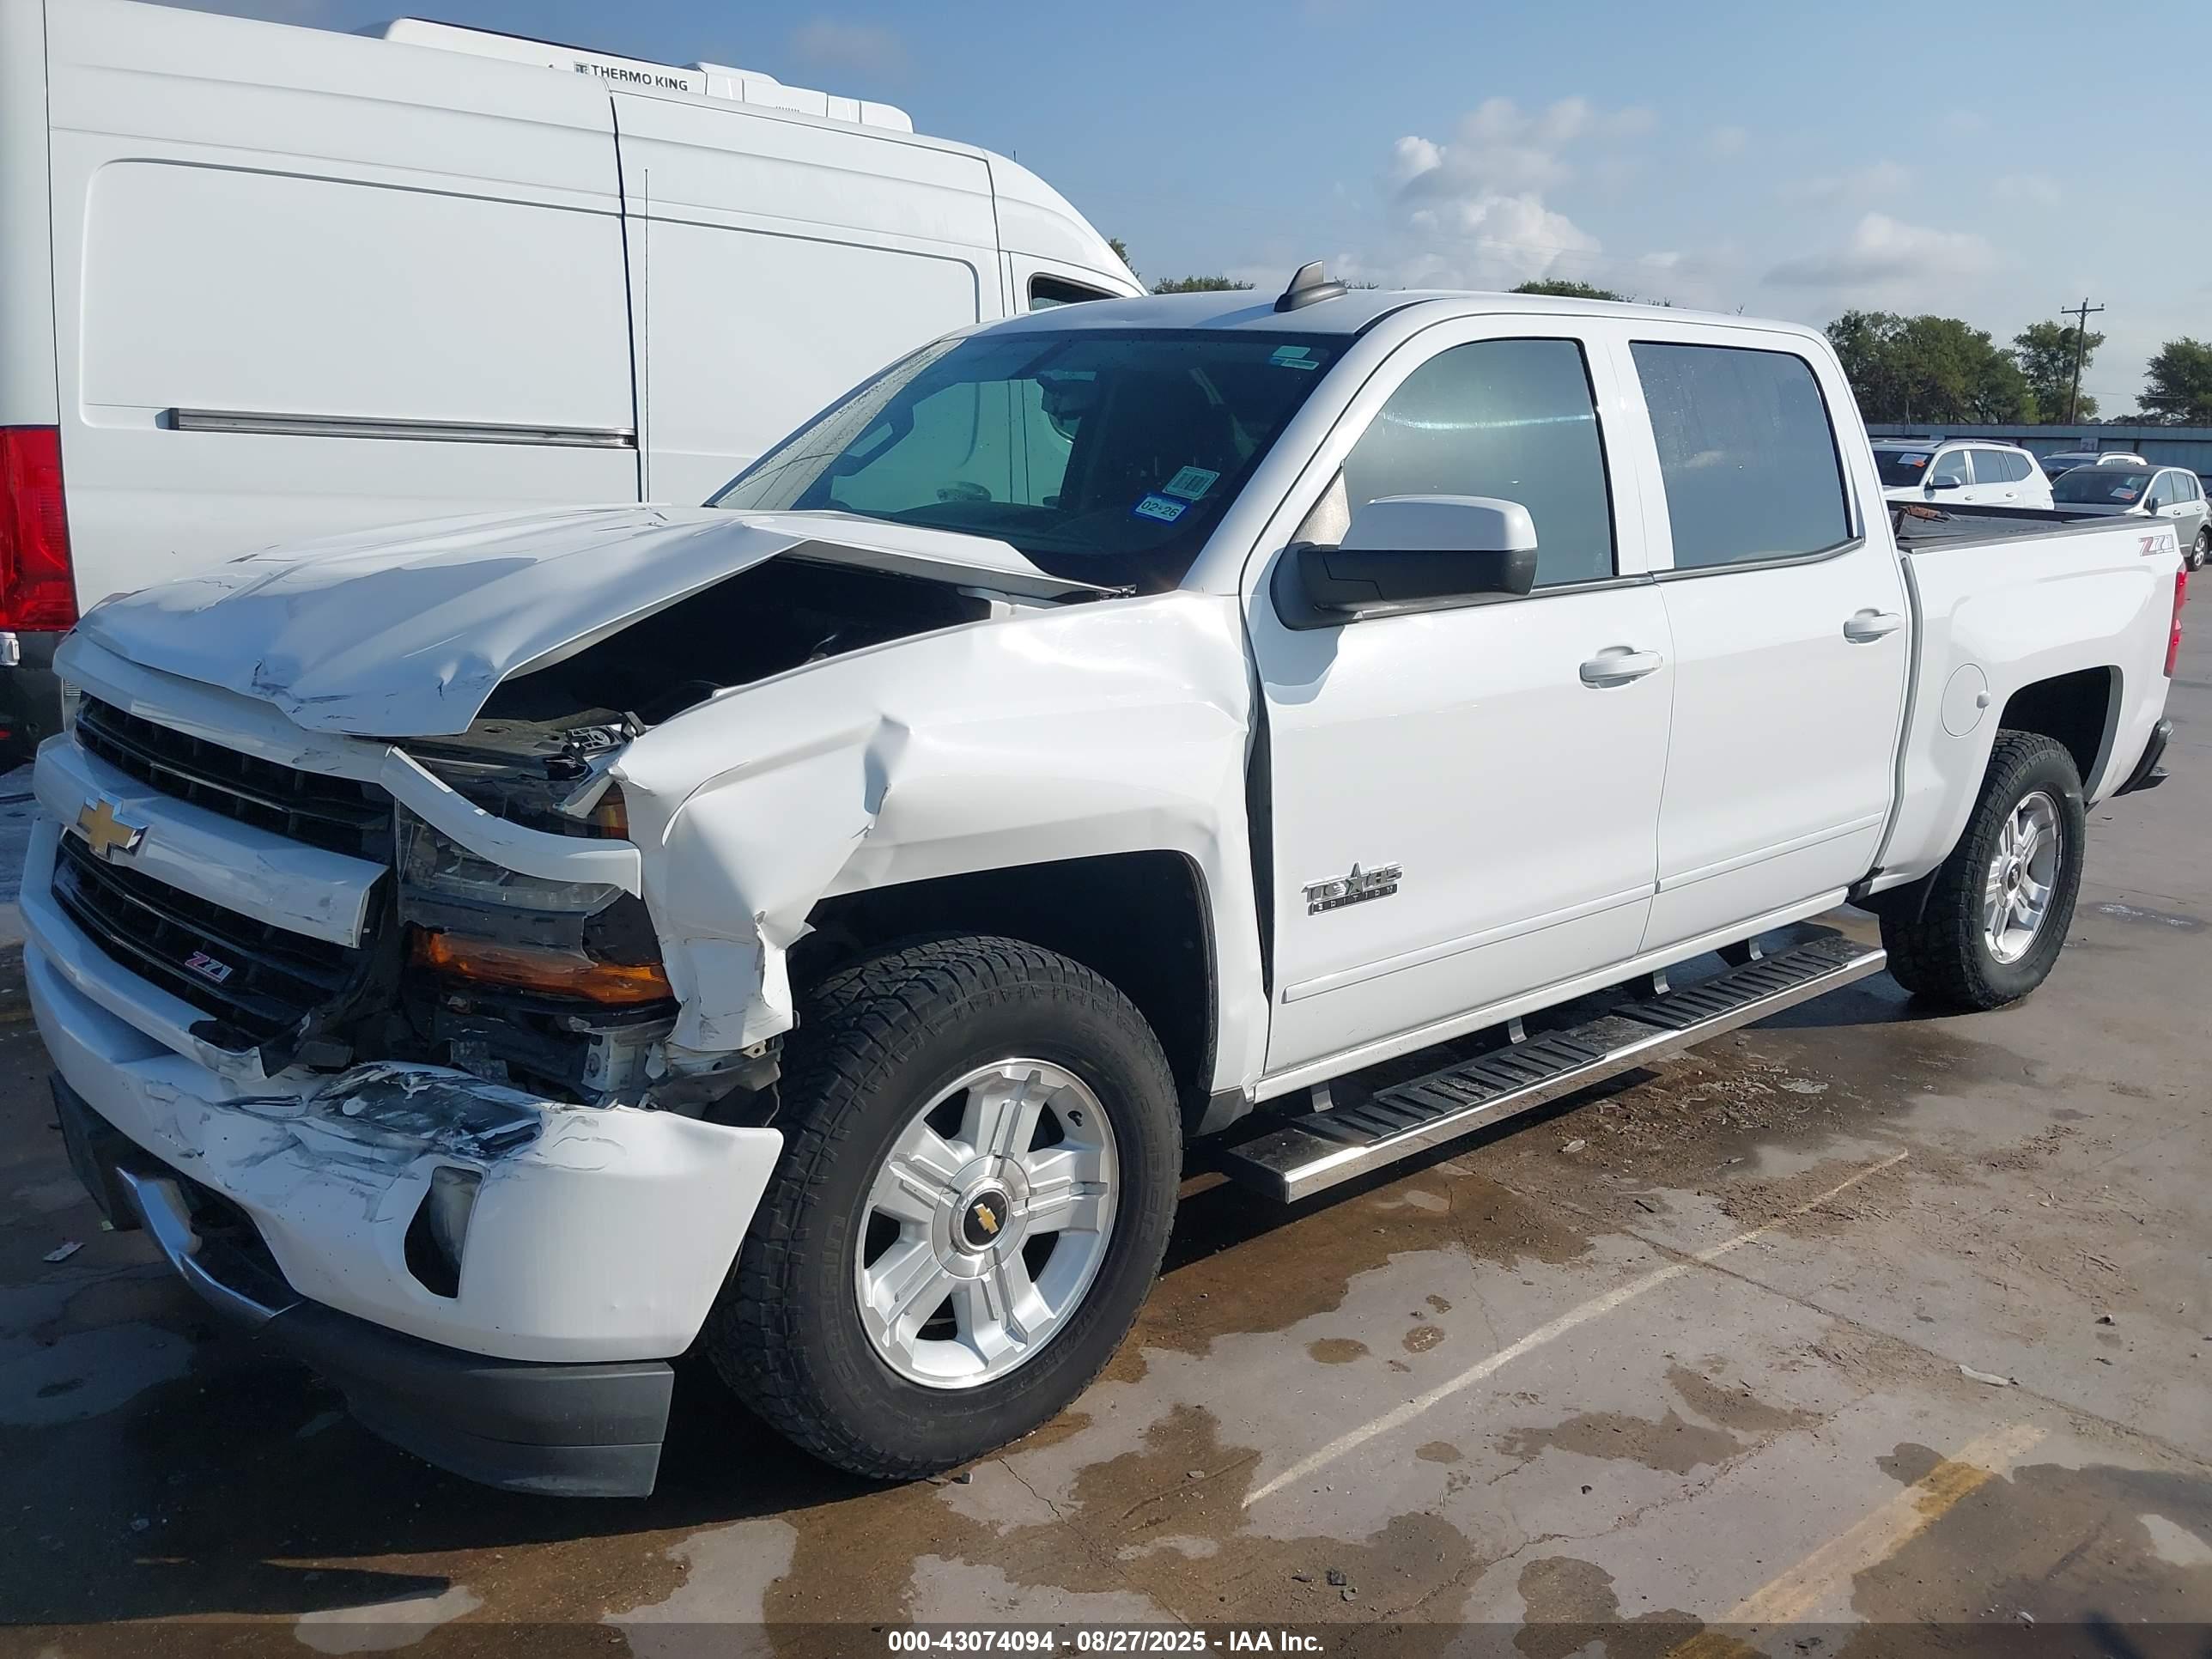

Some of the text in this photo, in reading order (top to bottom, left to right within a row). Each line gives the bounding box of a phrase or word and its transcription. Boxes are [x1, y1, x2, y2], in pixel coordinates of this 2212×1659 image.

[591, 64, 688, 91] THERMO KING
[1141, 501, 1180, 517] 02-26
[2138, 534, 2174, 556] Z71
[1301, 861, 1403, 903] TEXAS
[1317, 885, 1395, 911] EDITION
[185, 951, 233, 983] Z71
